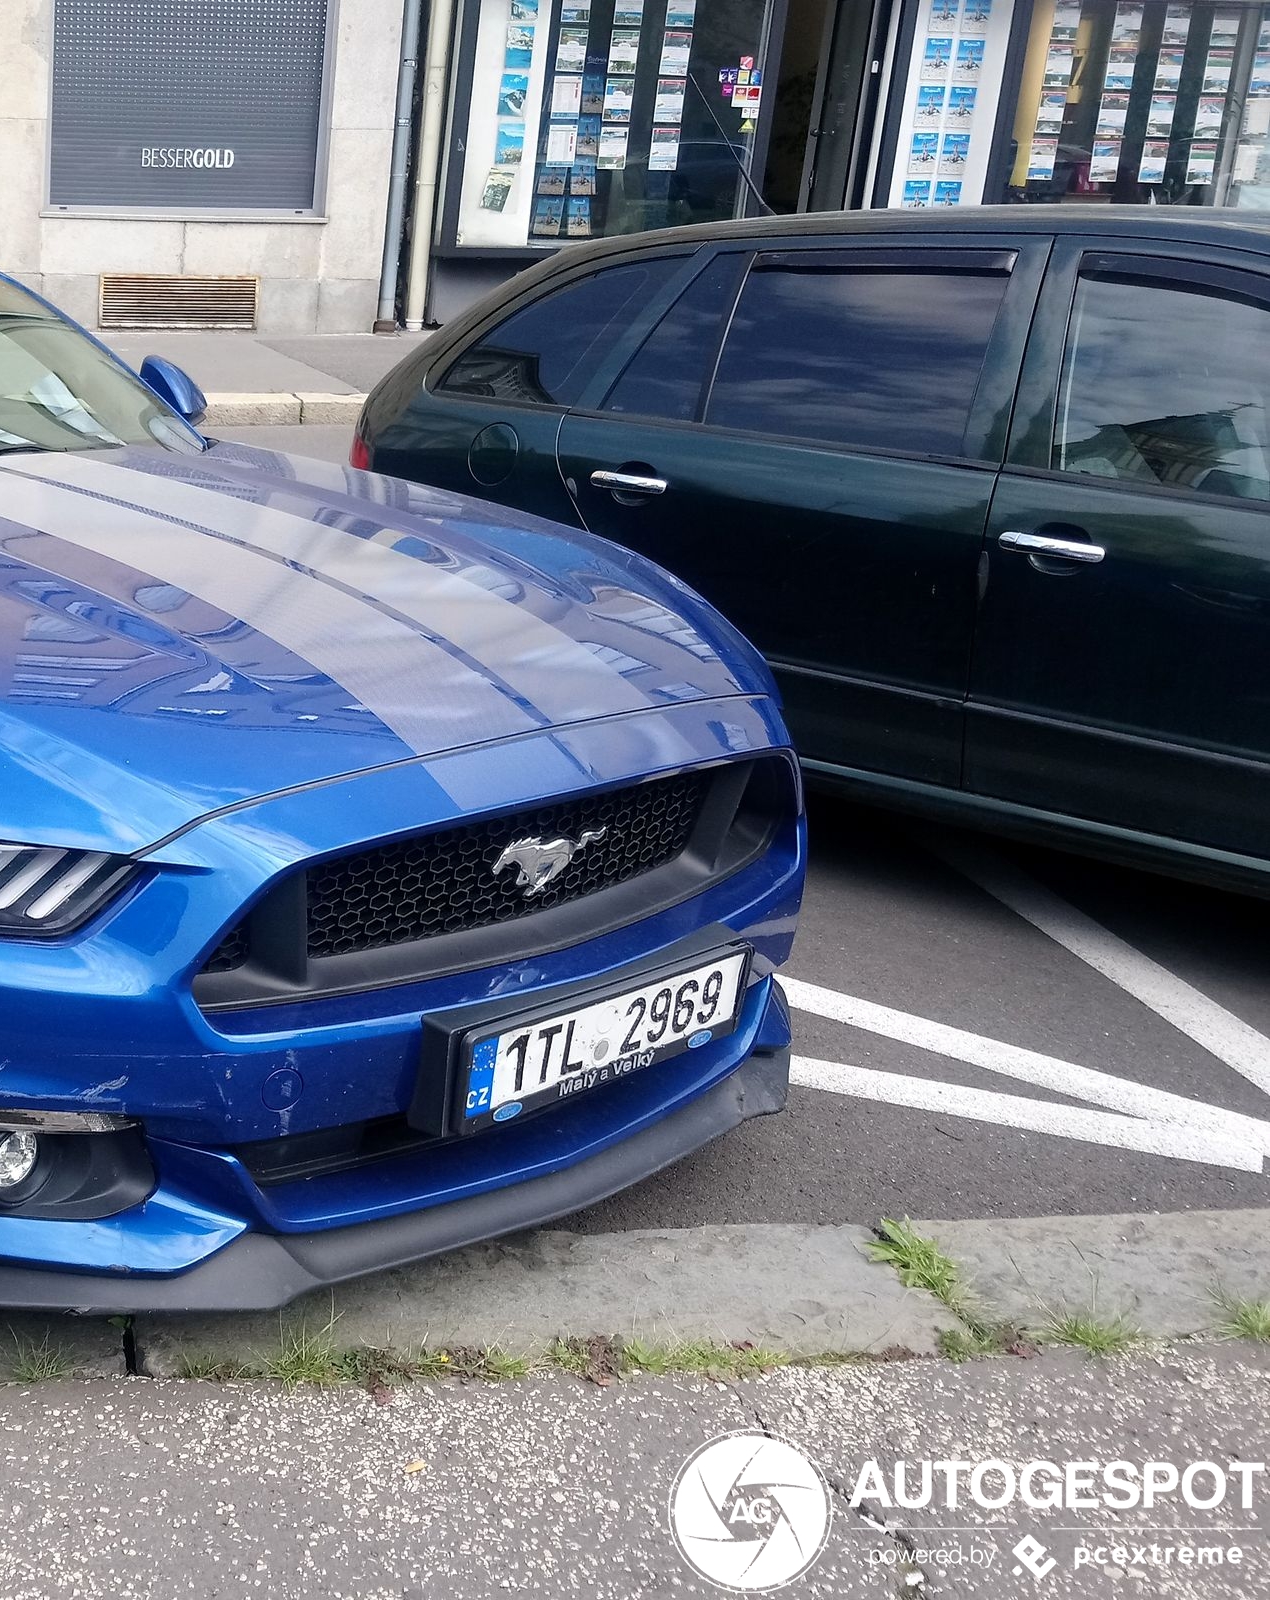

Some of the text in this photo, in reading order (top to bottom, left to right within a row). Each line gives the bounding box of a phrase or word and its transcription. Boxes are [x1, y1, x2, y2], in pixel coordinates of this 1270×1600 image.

[141, 148, 235, 168] BESSERGOLD
[506, 971, 724, 1092] 1TL 2969
[558, 1048, 656, 1097] Malý a Velký
[466, 1087, 489, 1110] CZ
